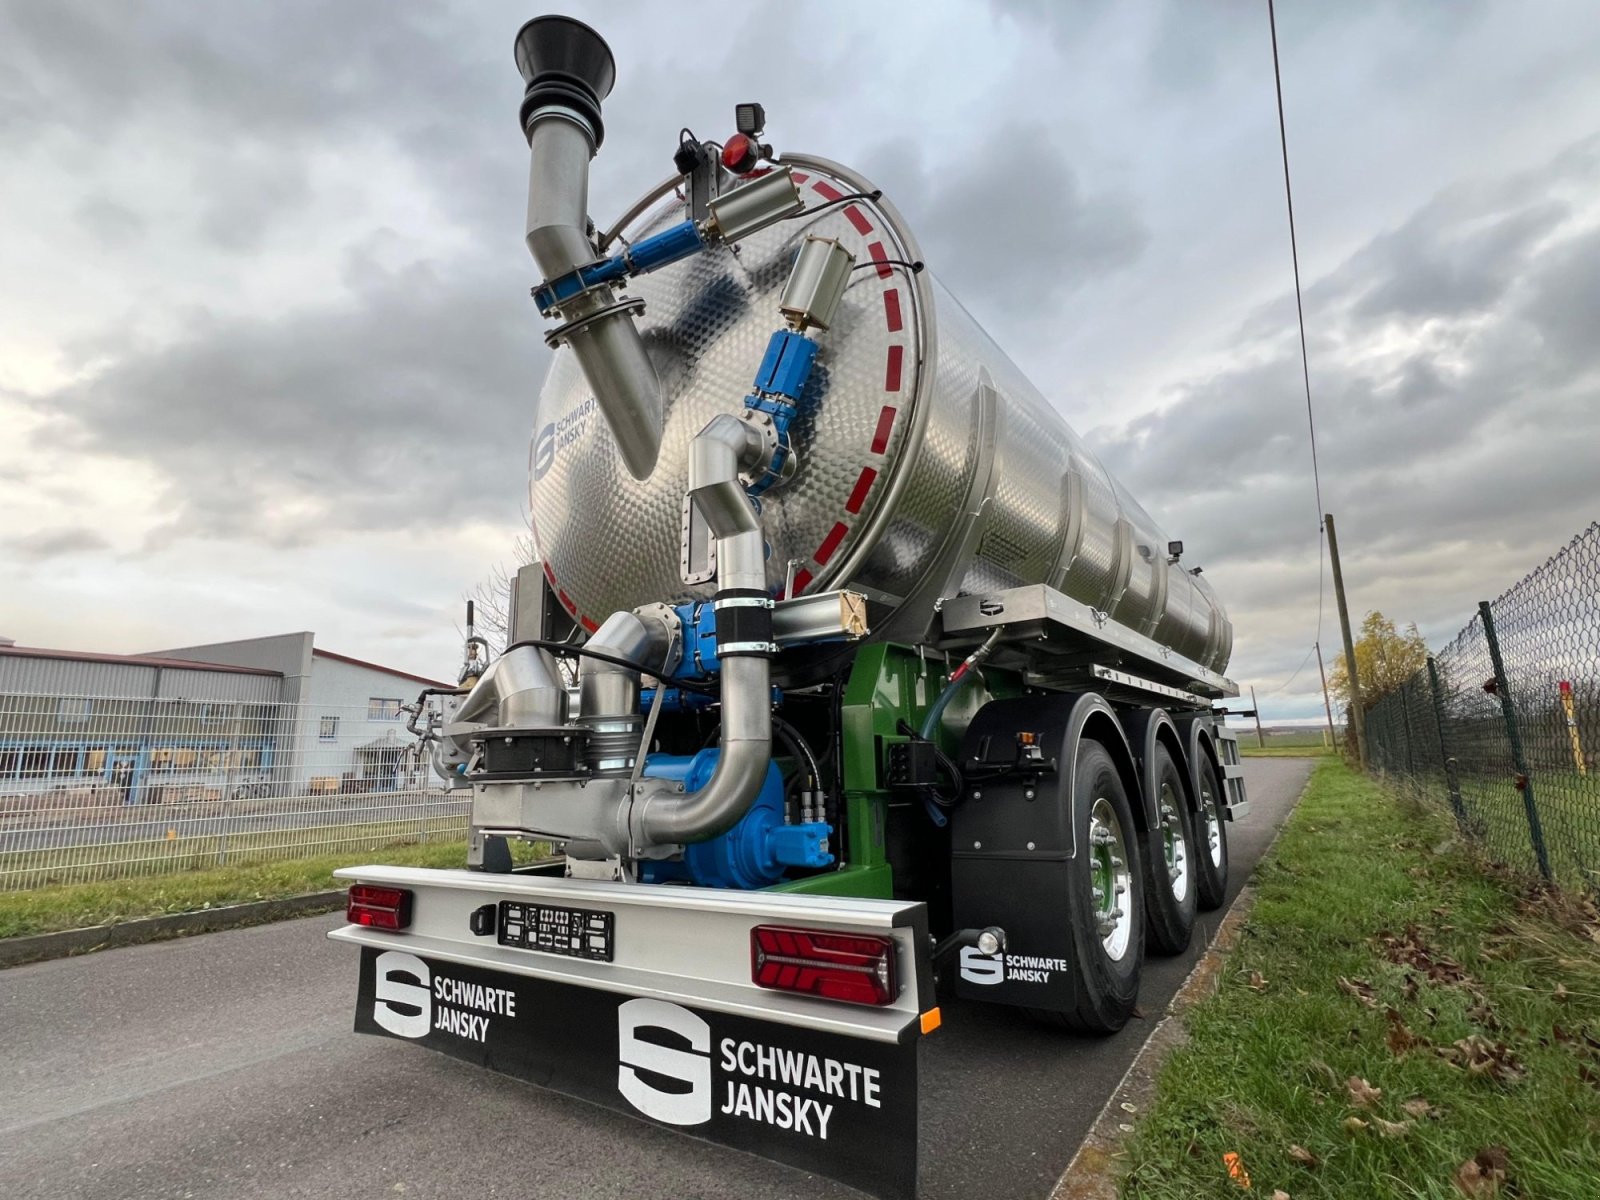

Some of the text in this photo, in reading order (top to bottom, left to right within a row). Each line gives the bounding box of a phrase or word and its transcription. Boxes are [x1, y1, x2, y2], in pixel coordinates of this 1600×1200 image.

[1006, 955, 1067, 971] SCHWARTE
[1007, 968, 1049, 983] JANSKY
[434, 976, 516, 1017] SCHWARTE
[434, 1005, 490, 1043] JANSKY
[720, 1037, 881, 1108] SCHWARTE
[721, 1081, 833, 1140] JANSKY
